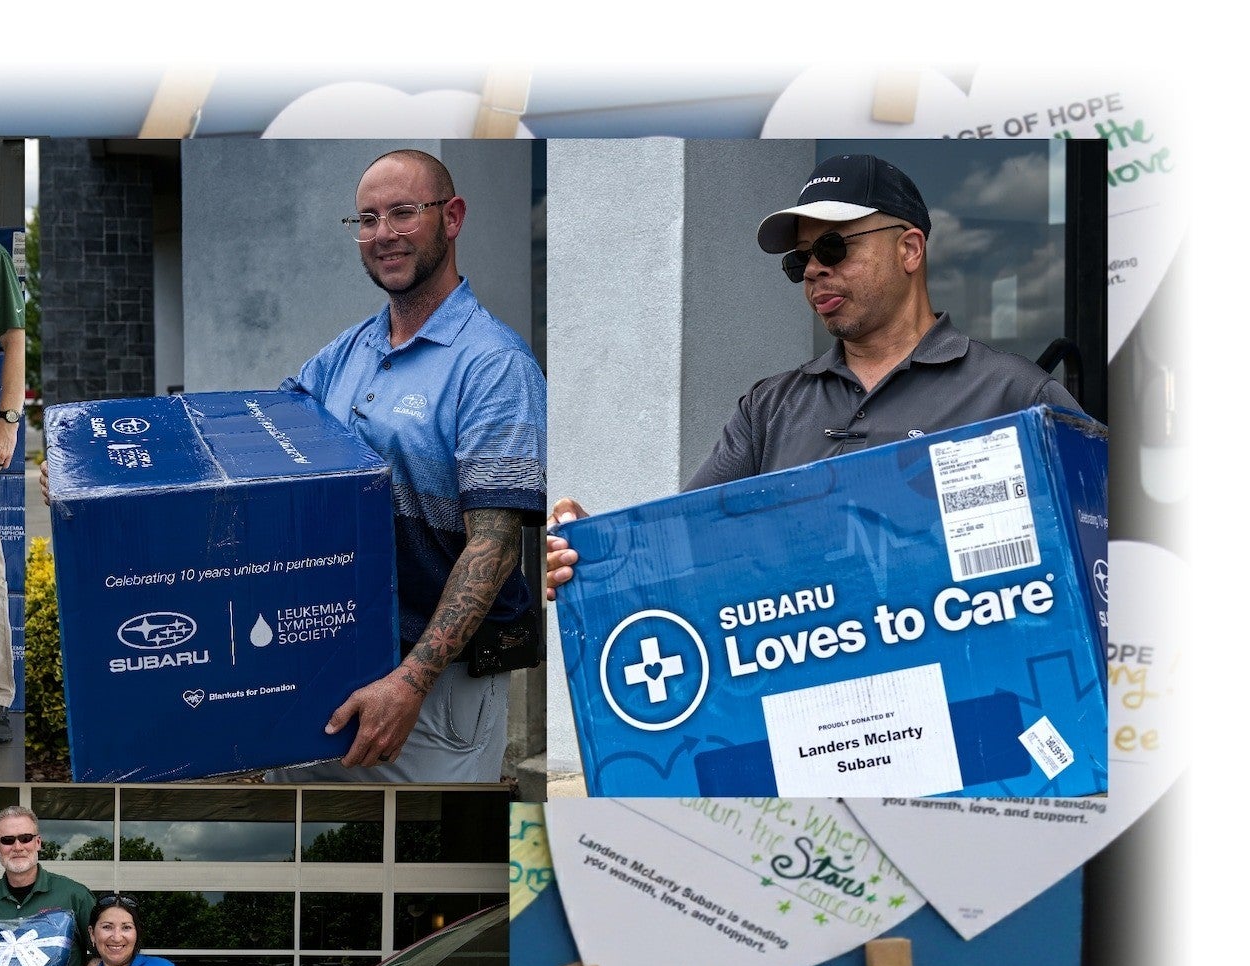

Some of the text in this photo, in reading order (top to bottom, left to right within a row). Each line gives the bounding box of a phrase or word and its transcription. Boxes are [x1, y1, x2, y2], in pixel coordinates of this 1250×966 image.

[1047, 93, 1124, 127] HOPE
[1016, 484, 1024, 496] G
[106, 552, 354, 588] Celebrating 10 years united in partnership!
[277, 600, 356, 620] LEUKEMIA &
[719, 584, 836, 630] SUBARU
[277, 612, 355, 633] LYMPHOMA
[724, 580, 1053, 678] Loves to Care
[278, 627, 338, 644] SOCIETY
[109, 650, 209, 672] SUBARU
[210, 682, 296, 701] Blankets for Donation
[818, 712, 895, 731] PROUDLY DONATED BY
[798, 738, 860, 758] Landers
[836, 753, 892, 773] Subaru
[969, 802, 1088, 825] love, and support.
[771, 837, 866, 898] Stars
[578, 834, 628, 866] Landers
[630, 860, 681, 894] McLarty
[682, 886, 726, 918] Subaru
[728, 910, 738, 923] is
[740, 917, 788, 950] sending
[584, 855, 766, 954] you warmth, love, and support.
